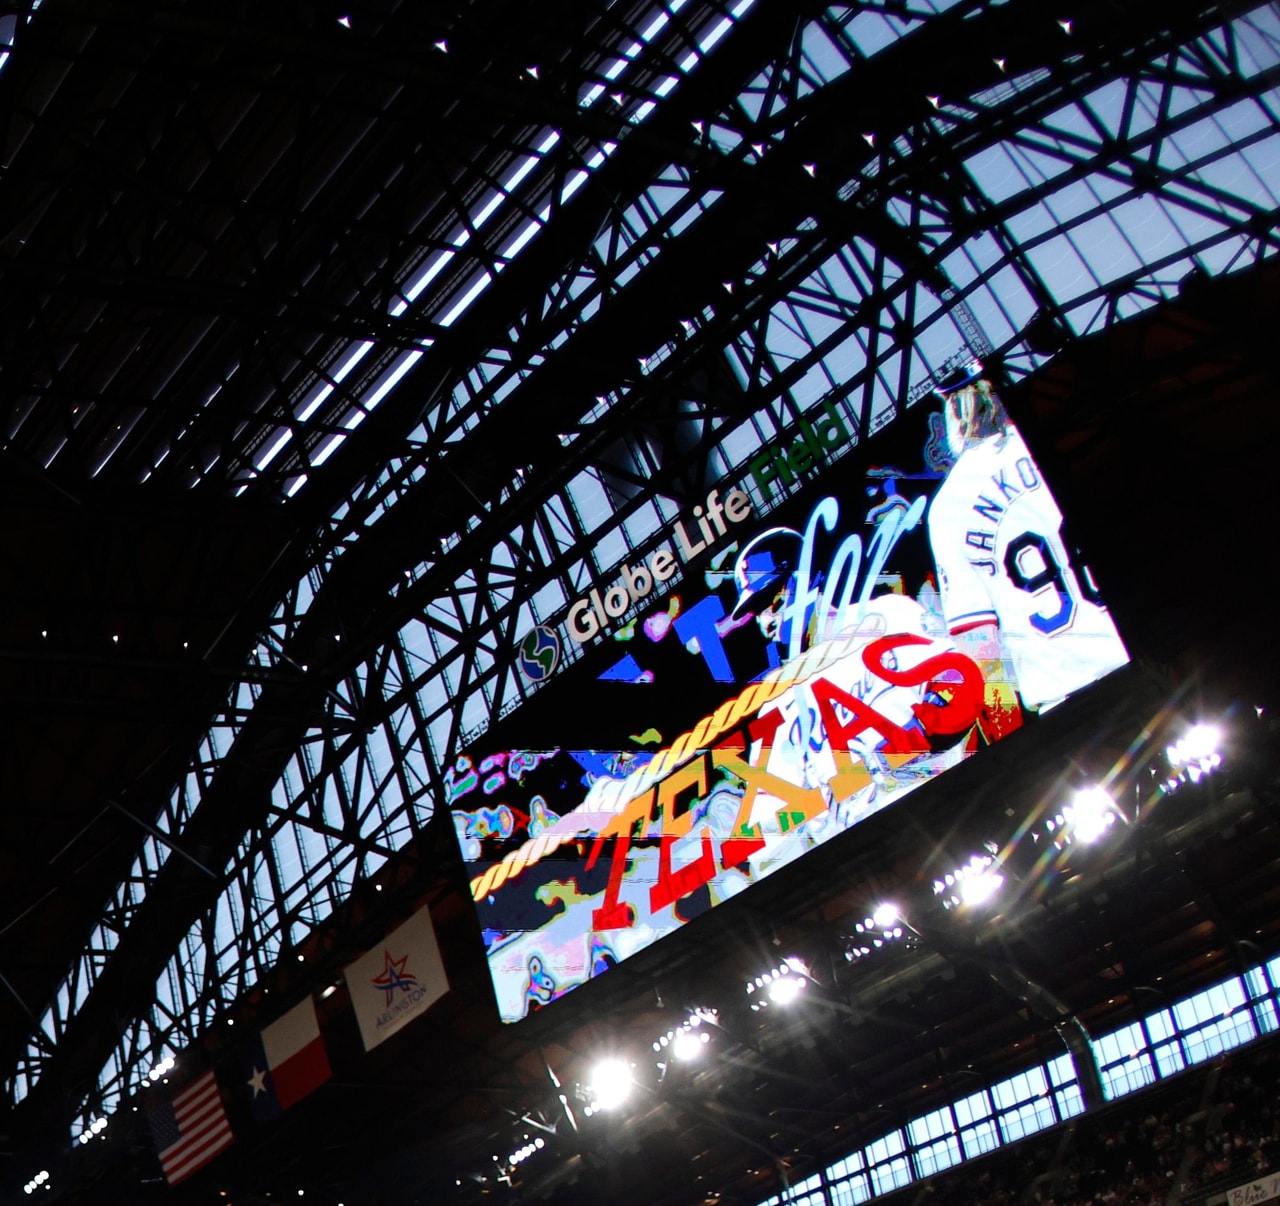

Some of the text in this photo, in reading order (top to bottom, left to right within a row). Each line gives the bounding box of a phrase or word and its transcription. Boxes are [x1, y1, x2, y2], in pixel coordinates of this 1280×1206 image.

[567, 400, 849, 643] Globe Life Field
[965, 457, 1044, 578] JANKO
[587, 634, 984, 932] TEXAS
[376, 983, 427, 1028] ARLINGTON
